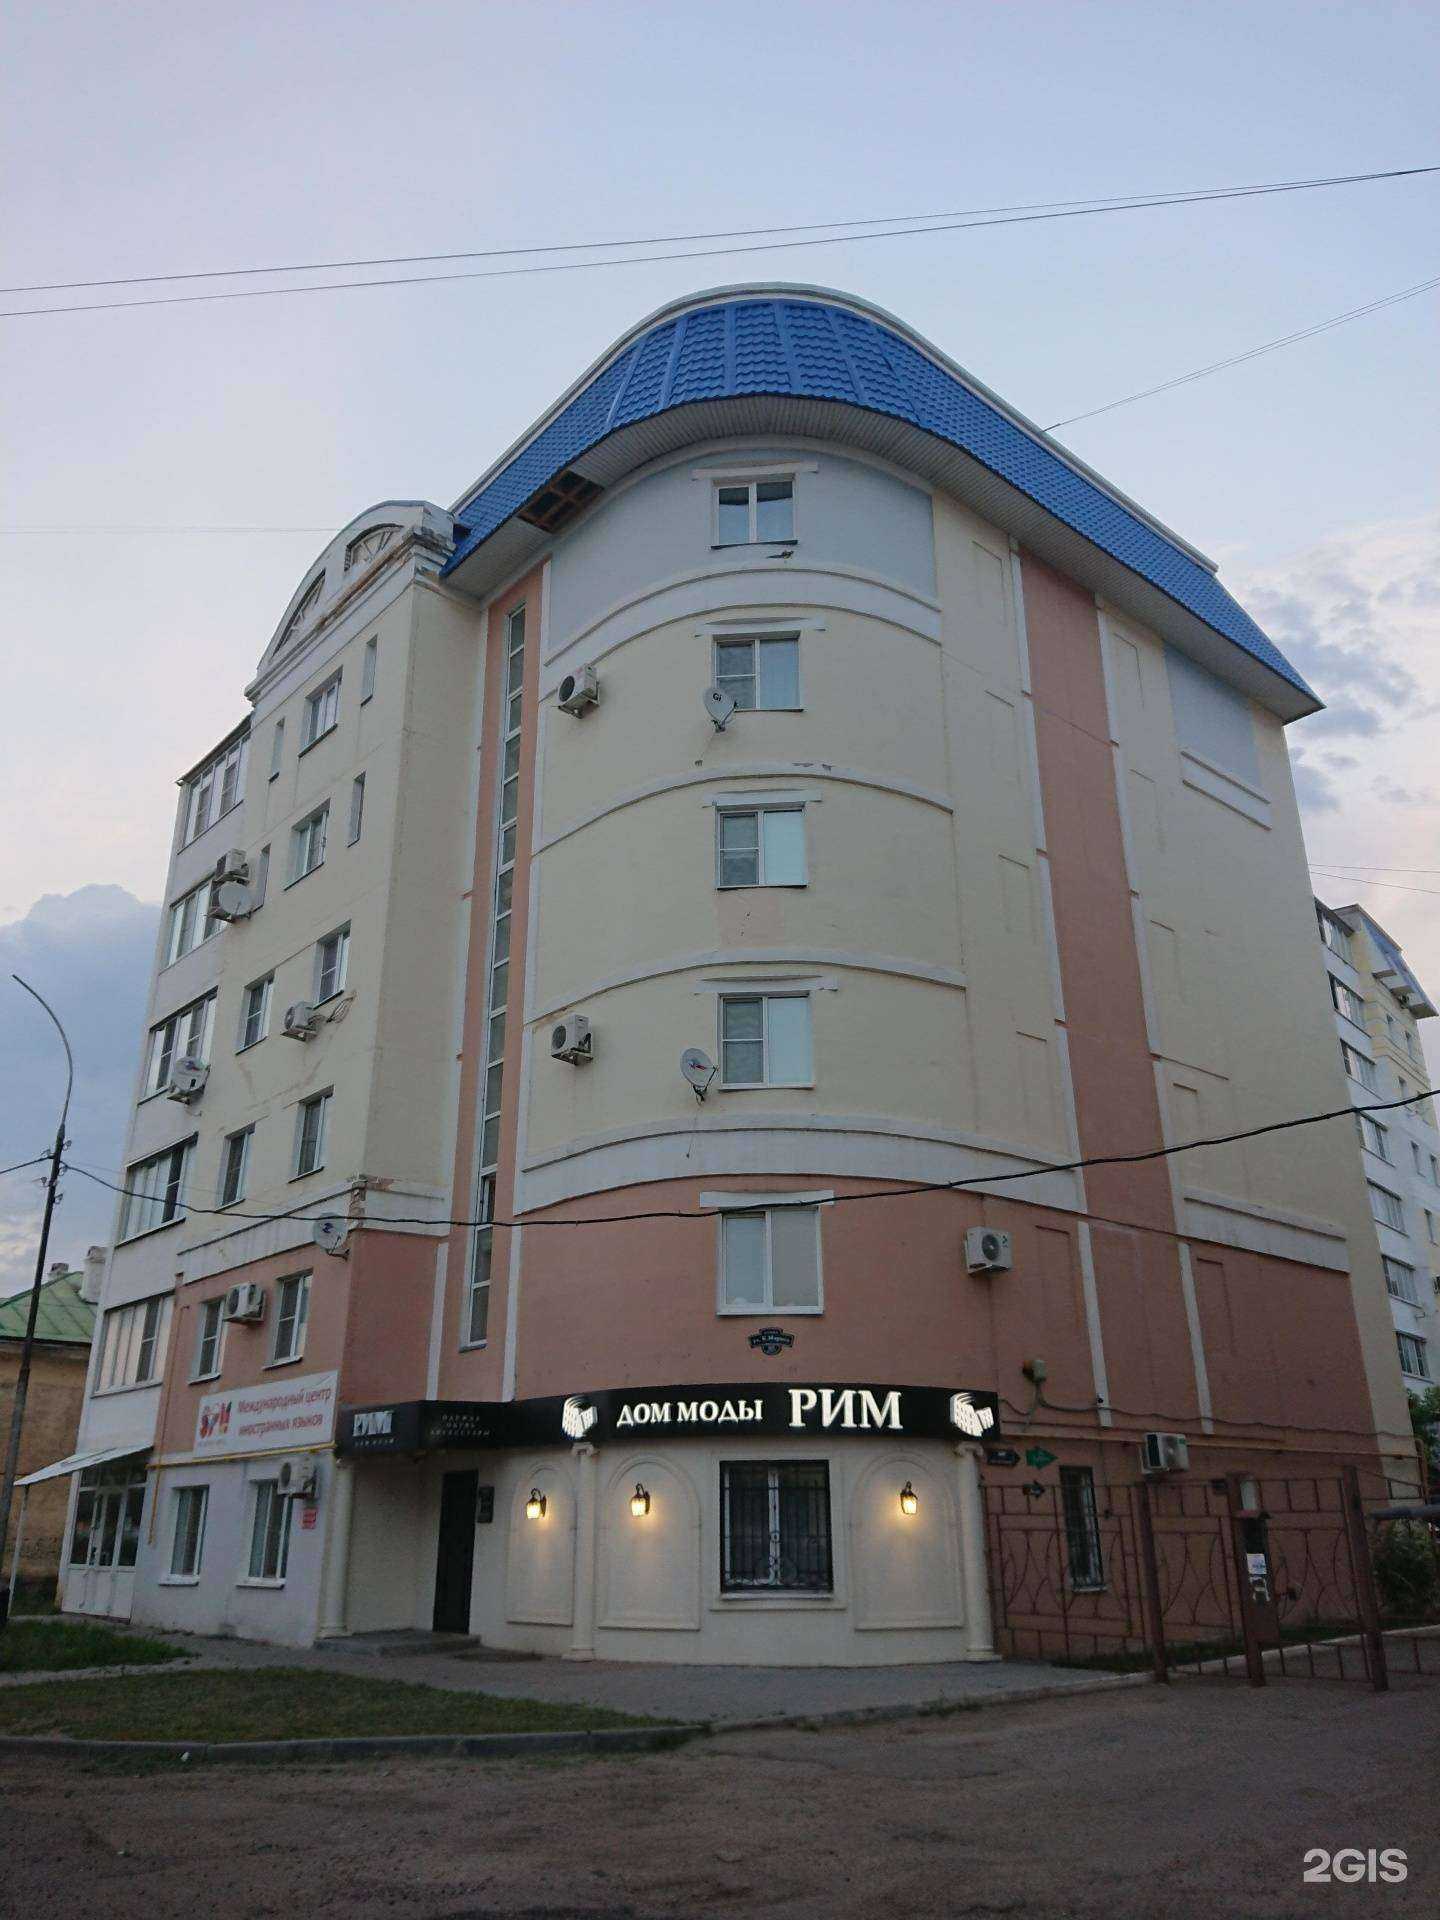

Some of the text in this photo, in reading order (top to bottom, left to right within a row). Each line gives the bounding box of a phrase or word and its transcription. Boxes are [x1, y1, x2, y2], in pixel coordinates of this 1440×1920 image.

[238, 1386, 332, 1414] Международный центр
[616, 1388, 904, 1430] ДОМ МОДЫ РИМ
[238, 1413, 324, 1438] иностранных языков
